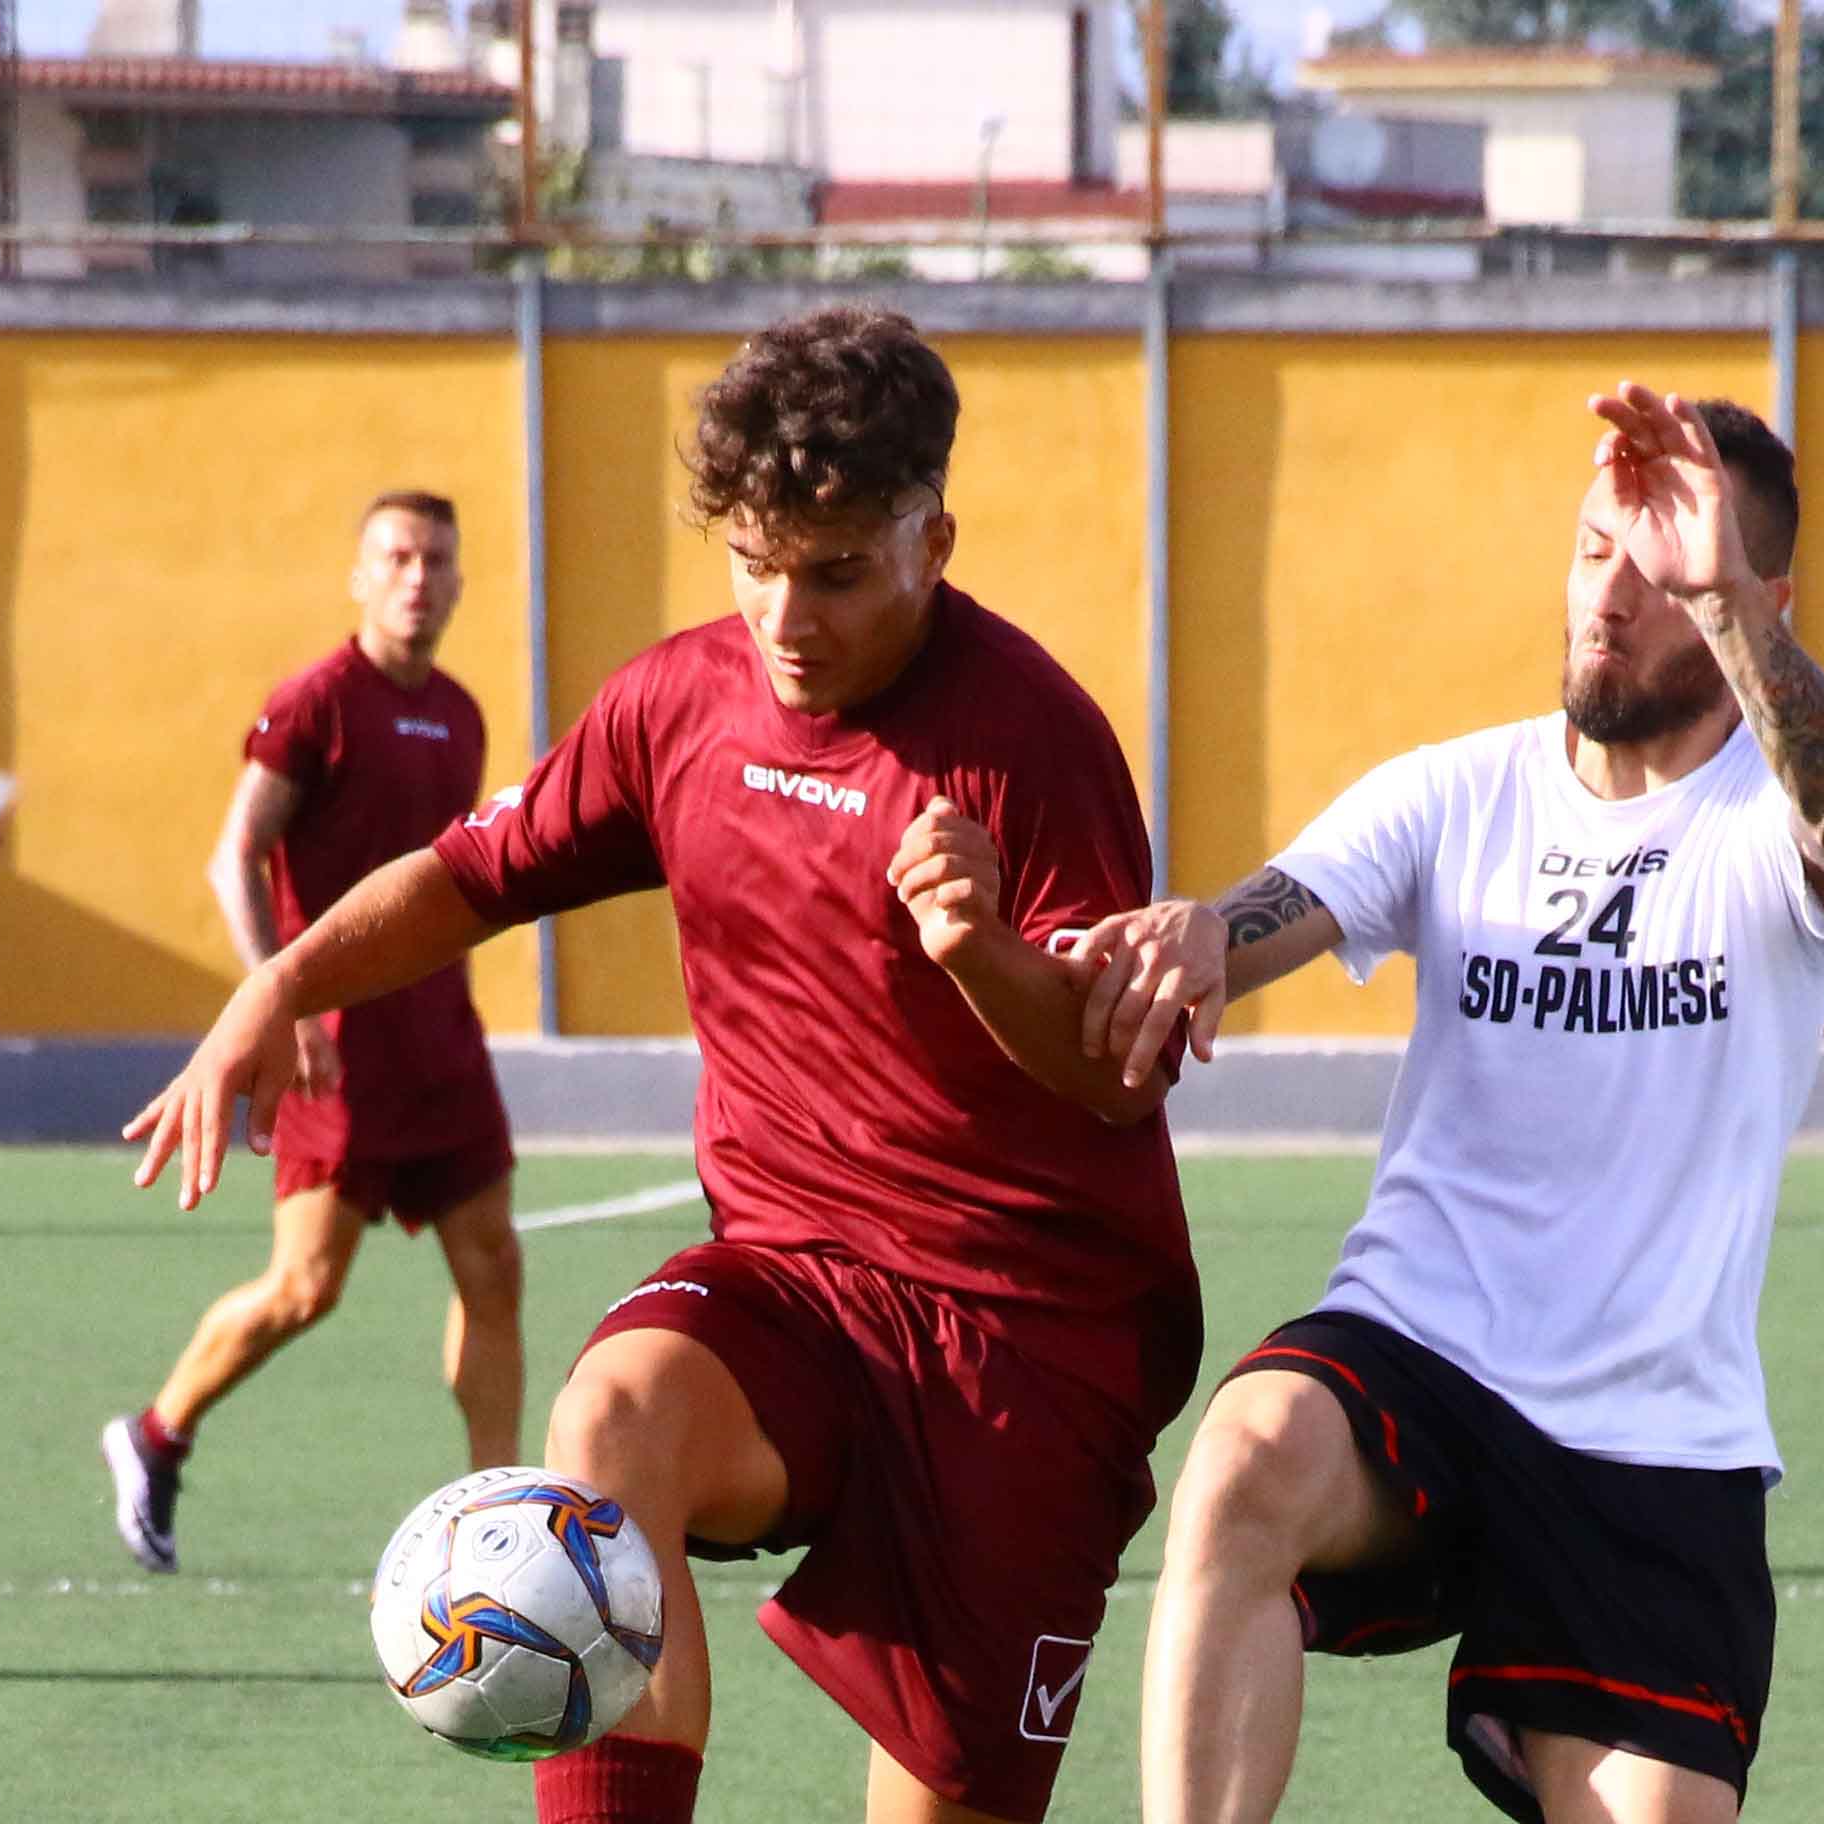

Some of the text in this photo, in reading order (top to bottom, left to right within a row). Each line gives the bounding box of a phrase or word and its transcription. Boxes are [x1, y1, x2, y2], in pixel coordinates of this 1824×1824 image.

[742, 763, 868, 817] GIVOVA
[1533, 883, 1637, 959] 24
[1459, 951, 1729, 1034] SD-PALMESE
